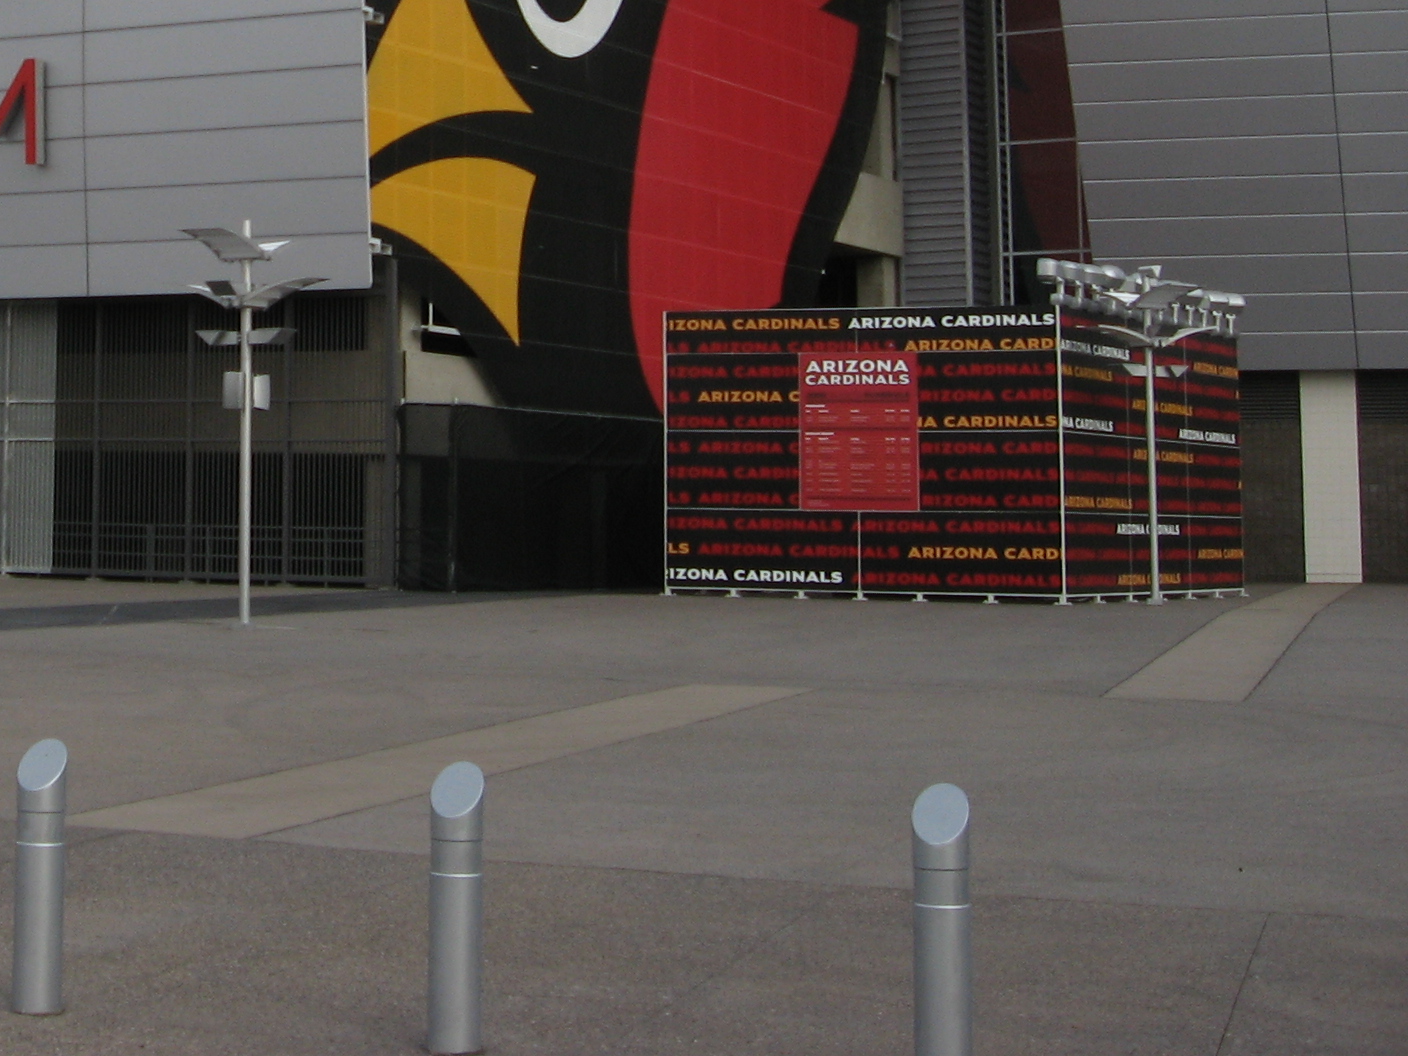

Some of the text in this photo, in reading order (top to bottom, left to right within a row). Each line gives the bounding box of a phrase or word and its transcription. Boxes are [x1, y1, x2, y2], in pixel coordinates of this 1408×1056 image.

[667, 319, 727, 331] IZONA
[732, 317, 840, 330] CARDINALS
[849, 316, 936, 329] ARIZONA
[941, 313, 1055, 327] CARDINALS
[697, 341, 782, 353] ARIZONA
[904, 339, 995, 352] ARIZONA
[1093, 345, 1130, 361] CARDINALS
[806, 360, 909, 373] ARIZONA
[943, 363, 1055, 376] CARDINALS
[805, 374, 910, 386] CARDINALS
[698, 391, 782, 403] ARIZONA
[943, 415, 1057, 428] CARDINALS
[1075, 416, 1114, 432] CARDINALS
[1179, 429, 1204, 442] ARIZONA
[1205, 431, 1235, 444] CARDINALS
[697, 441, 783, 454] ARIZONA
[945, 468, 1059, 481] CARDINALS
[697, 492, 783, 505] ARIZONA
[734, 518, 842, 532] CARDINALS
[851, 520, 939, 532] ARIZONA
[945, 520, 1060, 534] CARDINALS
[1117, 524, 1145, 535] ARIZONA
[1146, 524, 1180, 535] CDINALS
[697, 543, 783, 557] ARIZONA
[908, 547, 998, 559] ARIZONA
[734, 569, 843, 584] CARDINALS
[852, 573, 941, 586] ARIZONA
[946, 573, 1061, 587] CARDINALS
